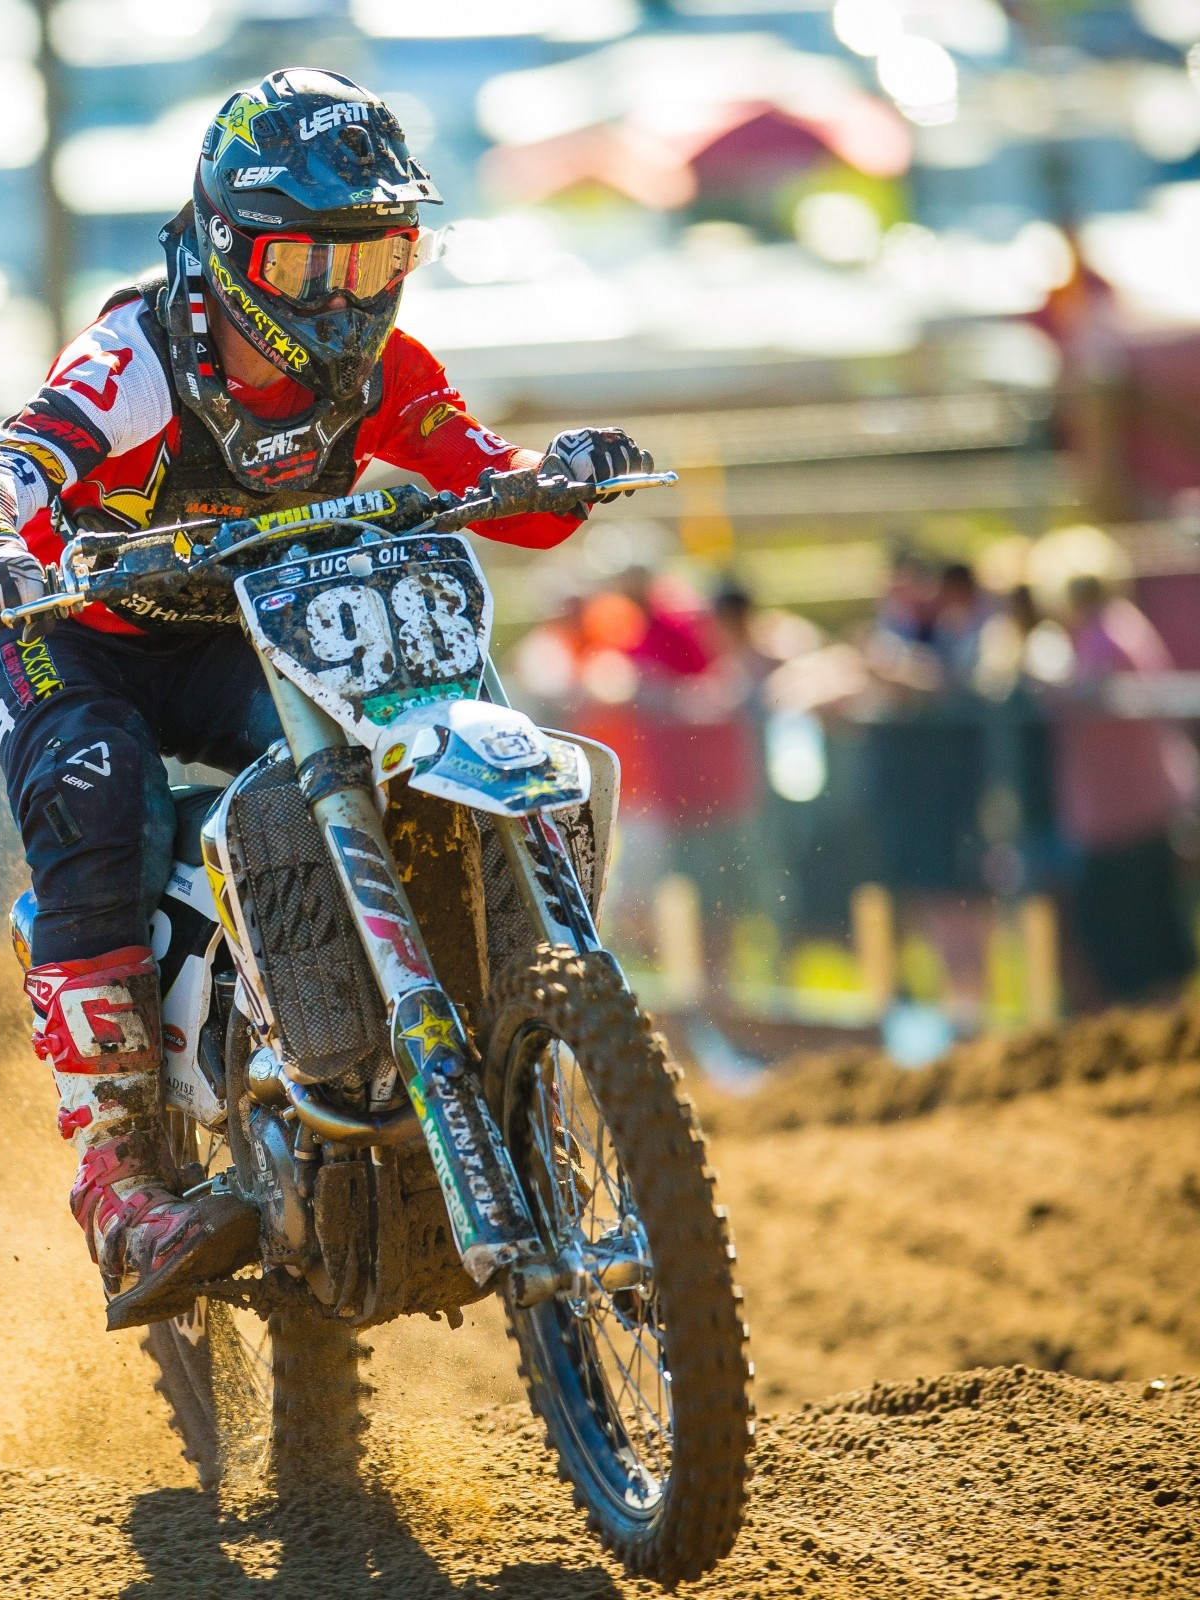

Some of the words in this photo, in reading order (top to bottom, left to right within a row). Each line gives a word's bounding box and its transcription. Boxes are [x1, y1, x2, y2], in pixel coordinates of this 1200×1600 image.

[299, 103, 369, 140] LEATT
[234, 166, 288, 187] LEATT
[378, 546, 410, 564] OIL
[304, 572, 480, 694] 98
[62, 774, 94, 791] LEATT
[166, 1076, 195, 1096] ADISE
[423, 1117, 474, 1245] MOTOREX
